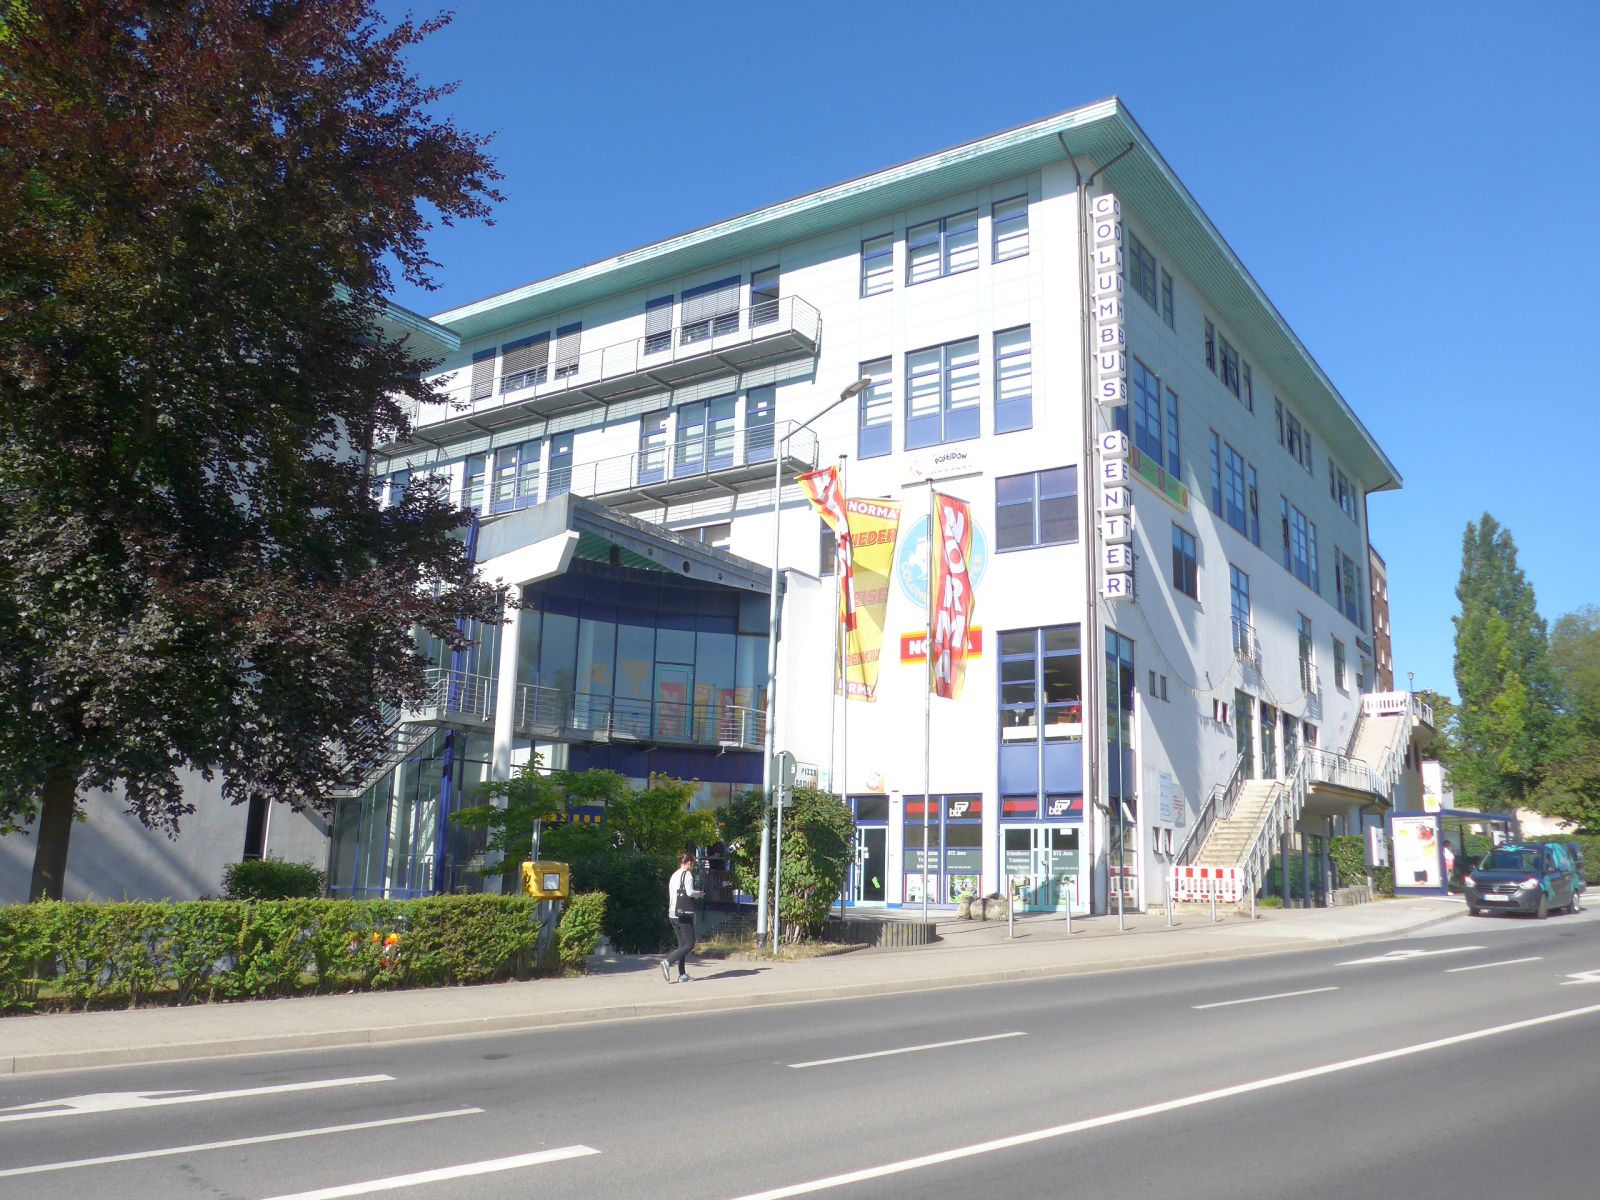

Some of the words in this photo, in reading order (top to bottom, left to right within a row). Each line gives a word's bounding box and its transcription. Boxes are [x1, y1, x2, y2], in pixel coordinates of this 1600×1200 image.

[1096, 199, 1116, 397] COLUMBUS
[848, 500, 897, 519] NORMA
[1103, 435, 1121, 593] CENTER
[1120, 436, 1133, 595] CENTER
[935, 505, 967, 684] NORMA
[801, 767, 817, 777] PIZZA
